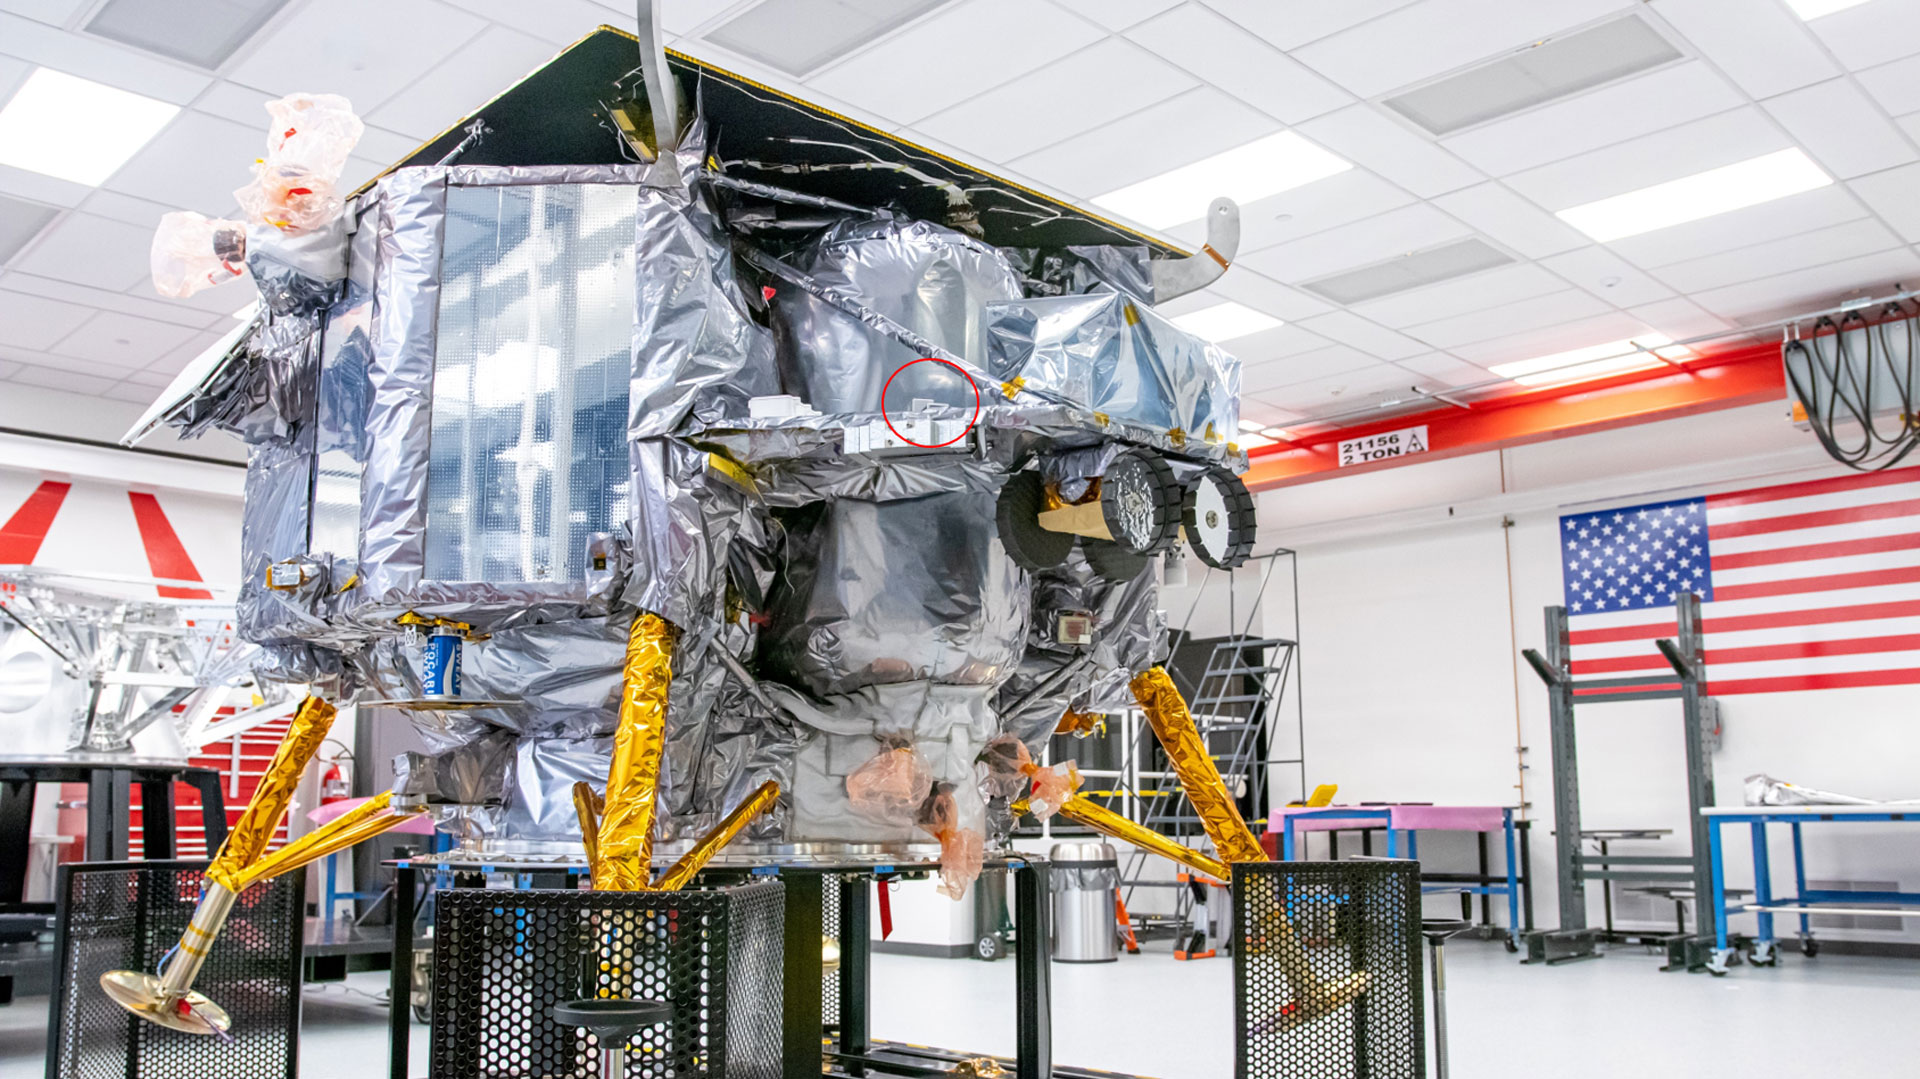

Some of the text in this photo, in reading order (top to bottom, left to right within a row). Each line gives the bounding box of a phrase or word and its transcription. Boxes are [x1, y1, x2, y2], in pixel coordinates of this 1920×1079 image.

[1343, 434, 1400, 453] 21156
[1343, 446, 1400, 465] 2 TON
[427, 642, 436, 694] POCARI
